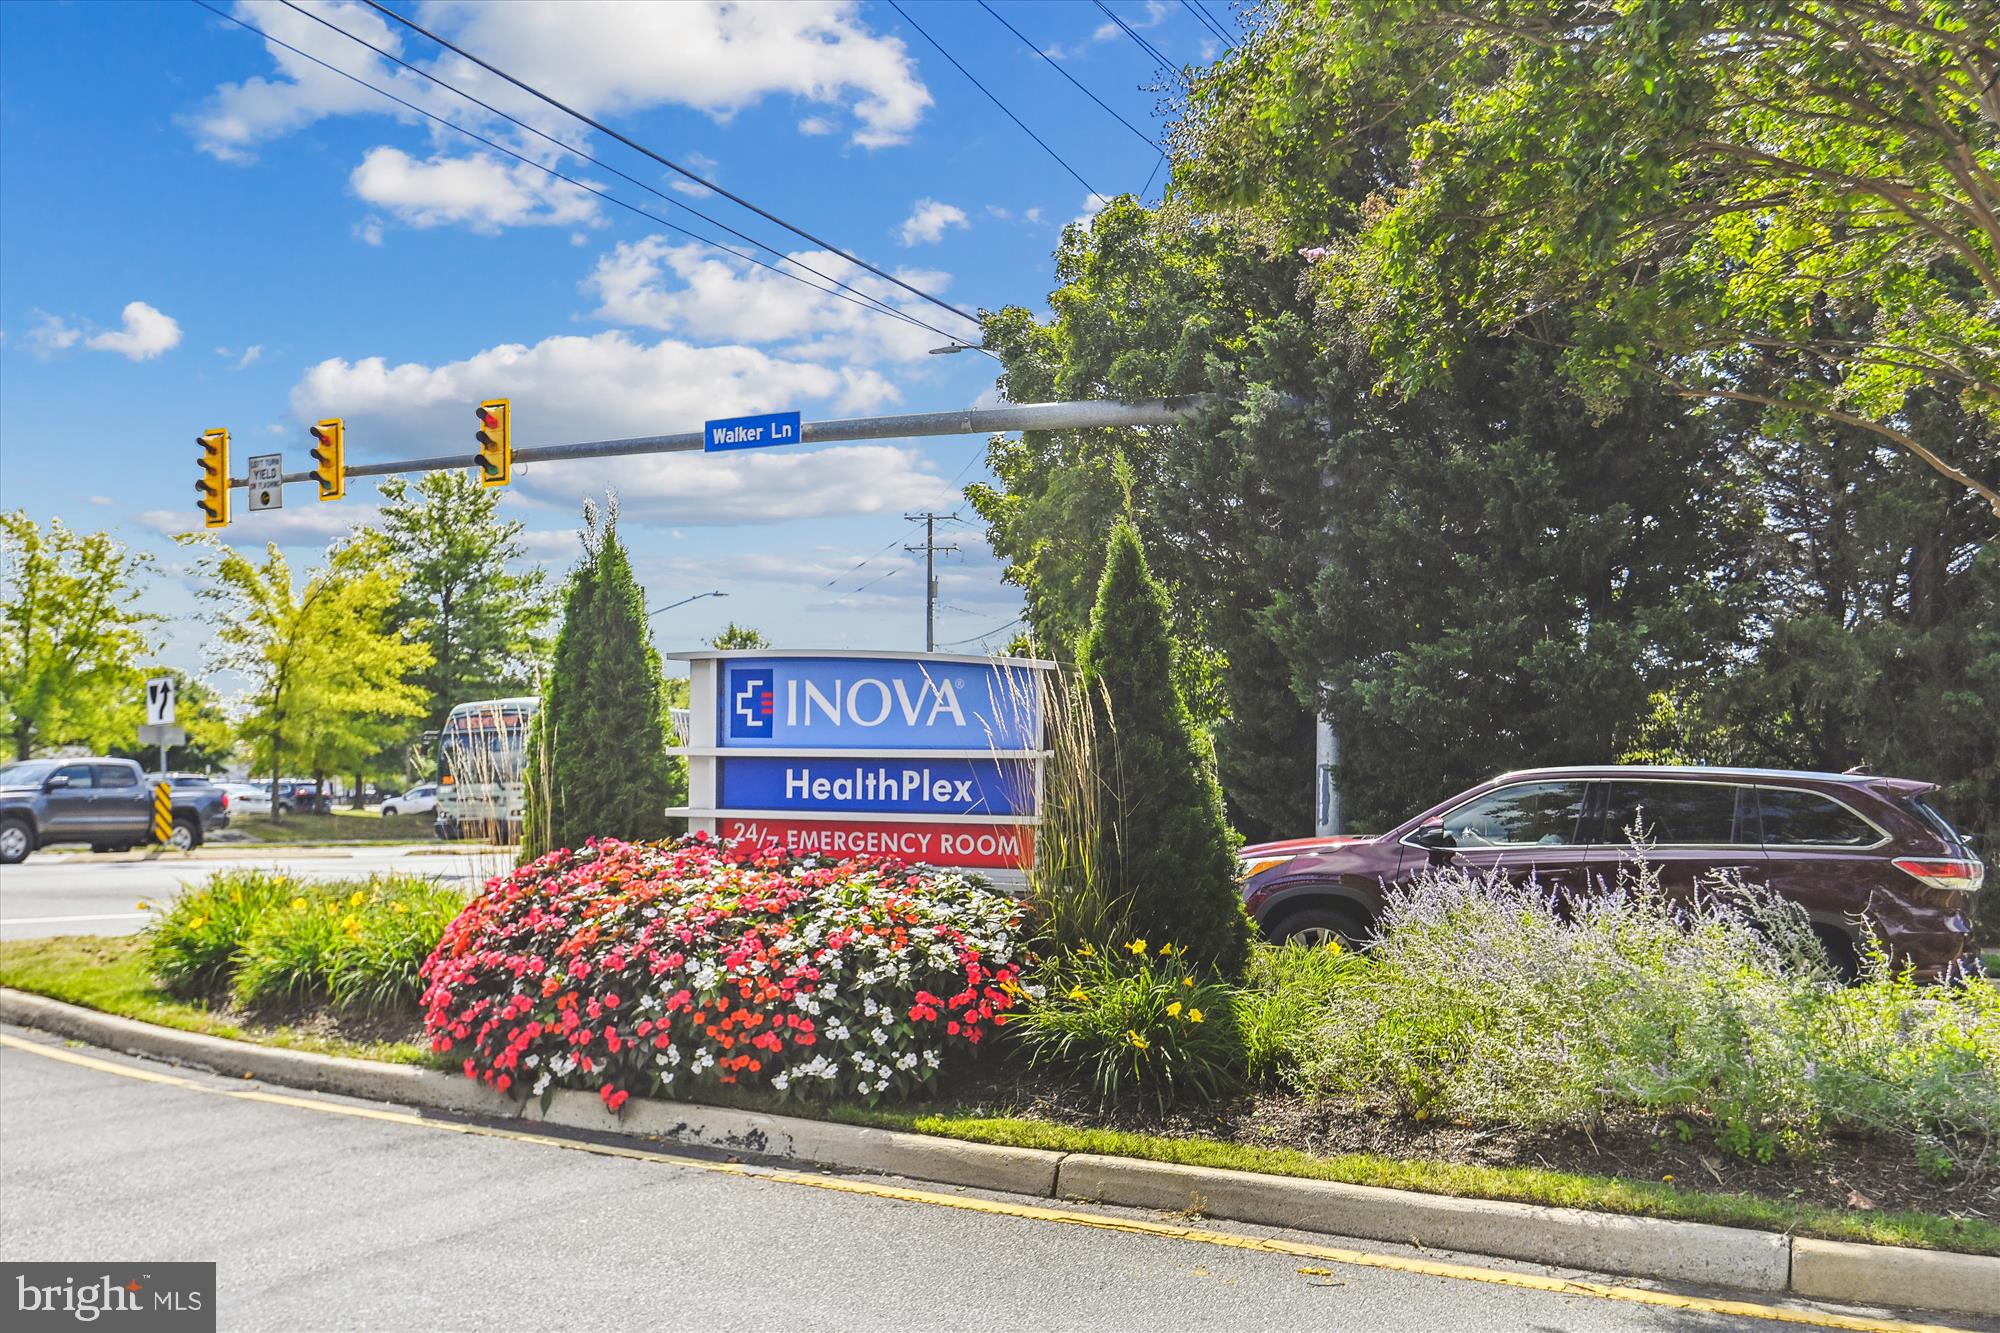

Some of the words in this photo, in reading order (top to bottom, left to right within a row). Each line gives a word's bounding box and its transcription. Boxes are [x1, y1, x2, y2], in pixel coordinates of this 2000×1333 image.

[713, 426, 764, 444] Walker
[771, 422, 792, 439] Ln
[253, 468, 277, 480] YIELD
[785, 768, 973, 802] HealthPlex
[787, 829, 932, 854] EMERGENCY
[940, 833, 1020, 857] ROOM
